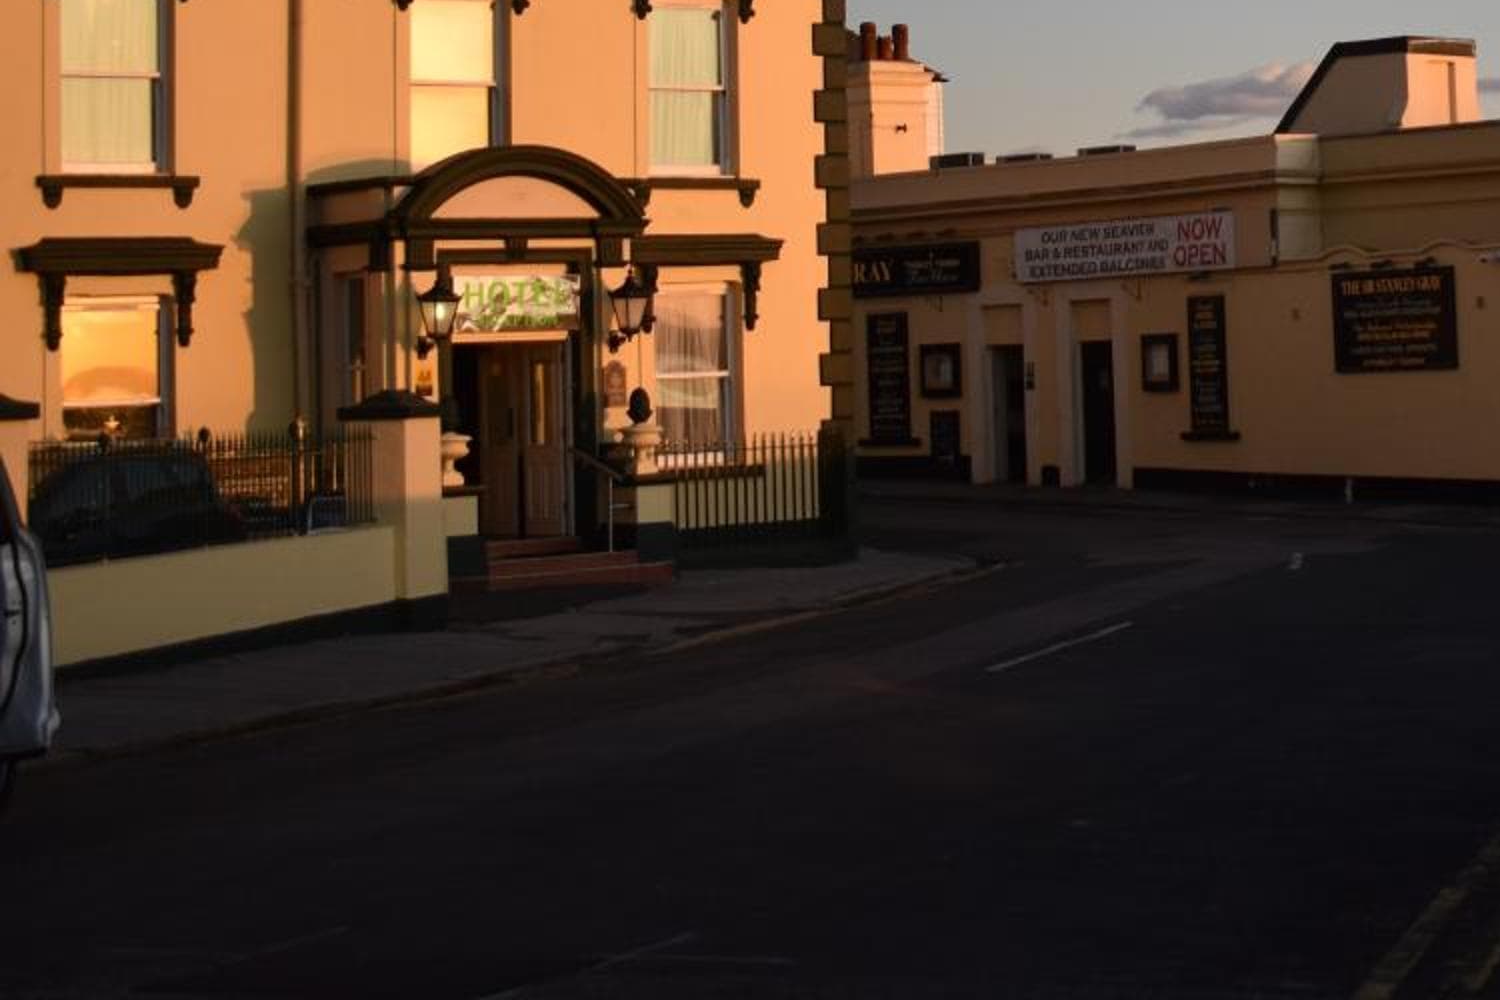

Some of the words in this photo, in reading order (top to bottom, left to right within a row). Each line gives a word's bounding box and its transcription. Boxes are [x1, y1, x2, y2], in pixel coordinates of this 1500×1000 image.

[1041, 231, 1070, 243] OUR
[1072, 228, 1099, 241] NEW
[1176, 216, 1223, 240] NOW
[1025, 247, 1050, 262] BAR
[1063, 242, 1145, 259] RESTAURANT
[1173, 243, 1227, 266] OPEN
[1029, 261, 1097, 279] EXTENDED
[464, 277, 567, 308] HOTEL
